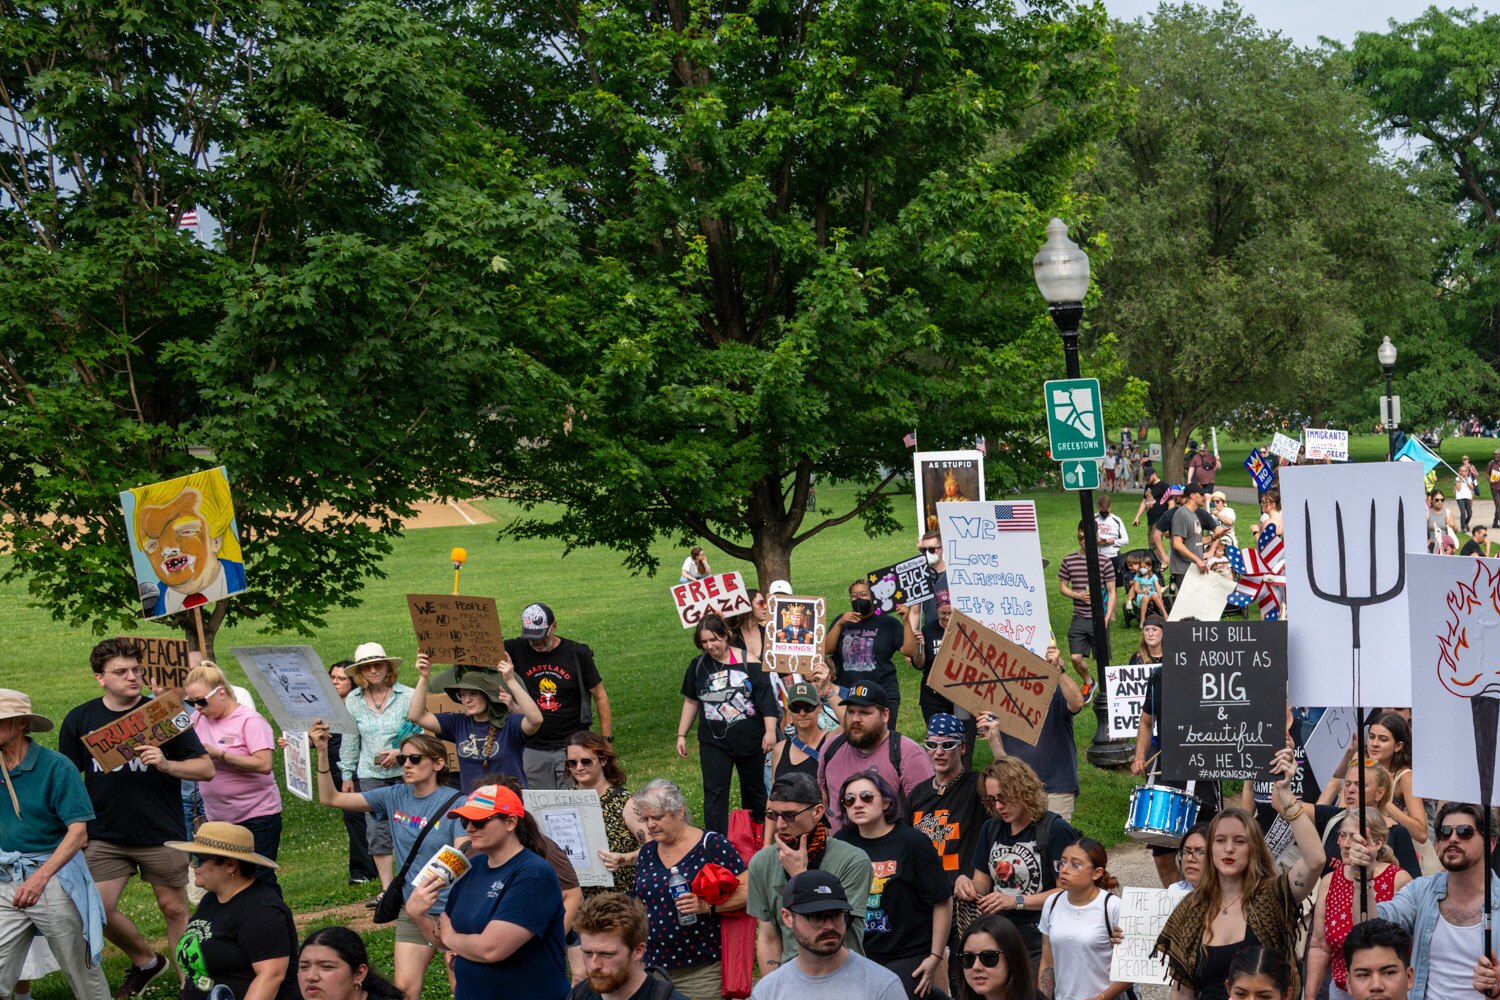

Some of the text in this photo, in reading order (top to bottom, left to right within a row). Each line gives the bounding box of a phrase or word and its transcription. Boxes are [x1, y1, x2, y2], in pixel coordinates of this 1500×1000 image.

[1307, 430, 1346, 440] IMMIGRANTS
[1058, 441, 1099, 451] GREEKTOWN
[928, 461, 972, 469] AS STUPID
[1258, 468, 1269, 482] NO
[899, 564, 930, 589] FUCK
[674, 573, 738, 607] FREE
[904, 580, 930, 601] ICE
[414, 601, 436, 615] WE
[454, 601, 490, 612] PEOPLE
[682, 594, 751, 625] GAZA
[1001, 597, 1033, 616] the
[436, 614, 450, 626] NO
[417, 630, 432, 641] WE
[450, 630, 462, 642] NO
[1192, 626, 1257, 642] HIS BILL
[451, 646, 466, 660] YES
[471, 656, 498, 665] PEACE
[1175, 650, 1272, 667] IS ABOUT AS
[525, 663, 571, 680] MARYLAND
[944, 654, 1042, 727] ÜBER ALLES
[1201, 671, 1247, 700] BIG
[1217, 706, 1228, 720] &
[86, 711, 148, 753] TRUMP
[1188, 752, 1264, 769] AS HE IS...
[1199, 769, 1257, 779] #NOKINGSDAY
[528, 794, 549, 806] NO
[1013, 845, 1038, 875] NIGHT
[1127, 892, 1150, 911] THE
[1120, 916, 1144, 936] THE
[1118, 959, 1158, 977] PEOPLE
